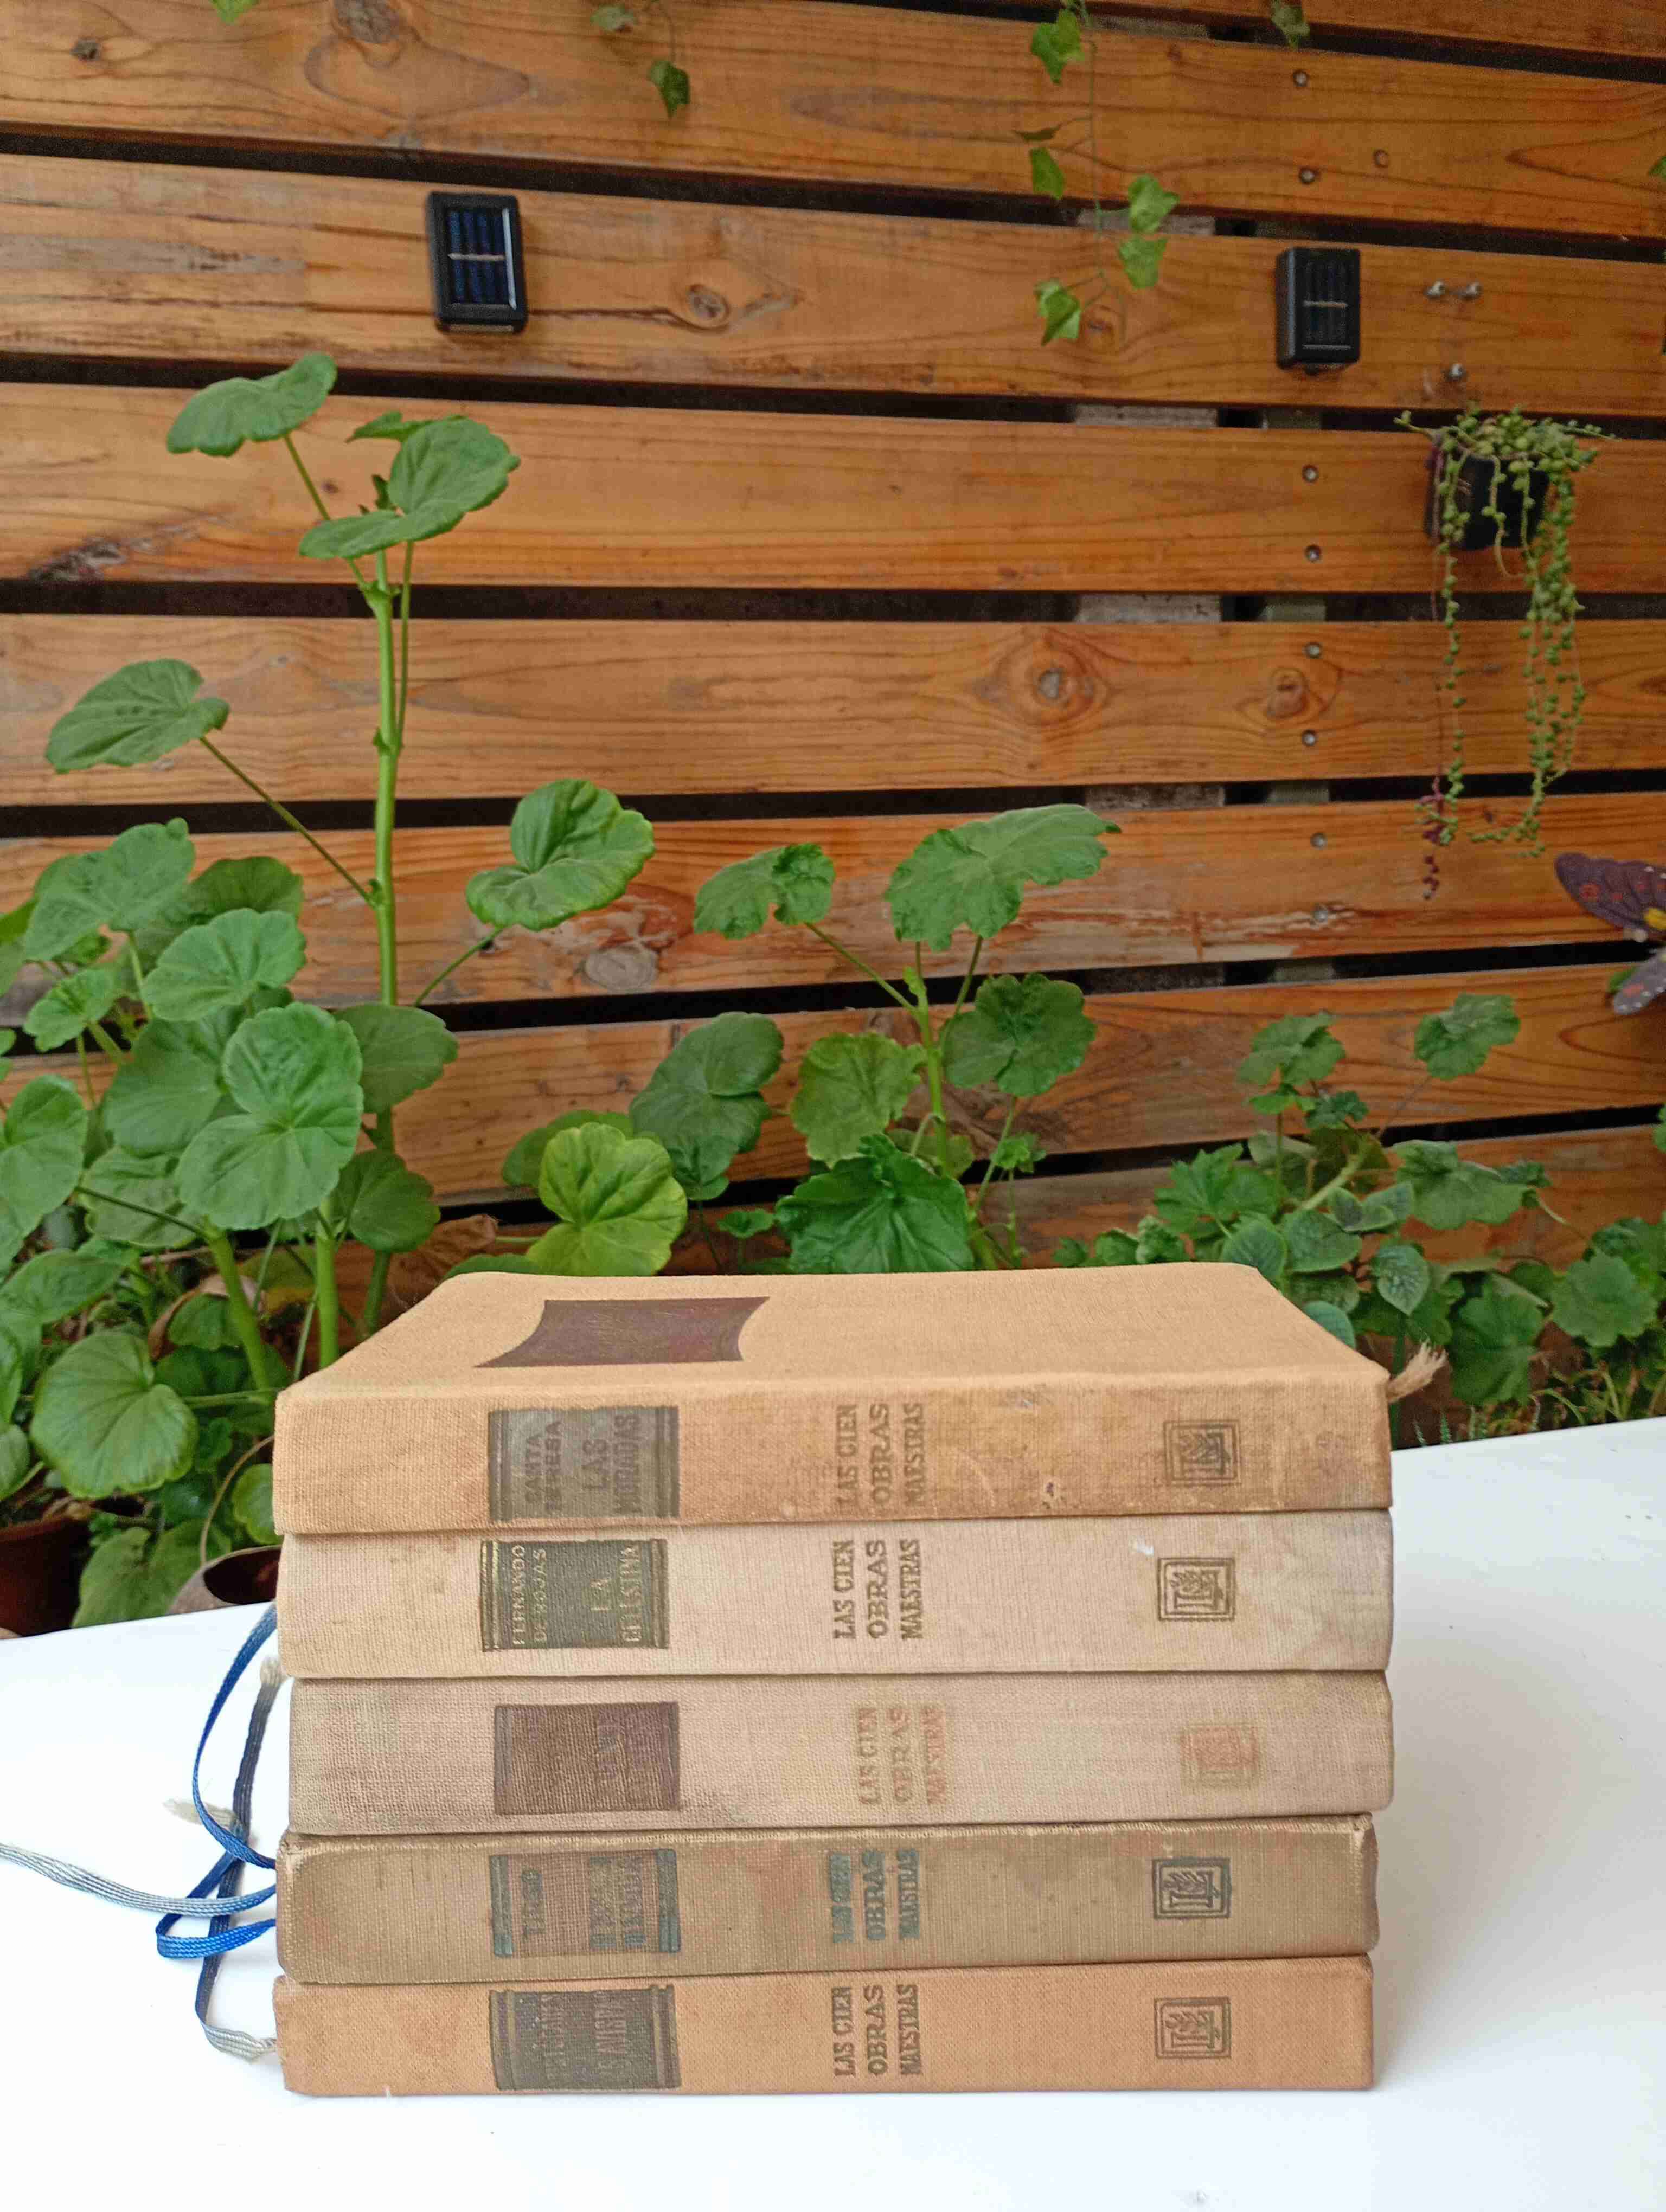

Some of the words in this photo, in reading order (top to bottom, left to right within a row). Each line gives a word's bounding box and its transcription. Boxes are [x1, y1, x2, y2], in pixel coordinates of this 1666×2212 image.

[524, 1434, 542, 1504] SANTA
[544, 1420, 562, 1512] TERESA
[581, 1438, 608, 1491] LAS
[613, 1413, 642, 1514] MORADAS
[836, 1405, 858, 1458] CIEN
[869, 1403, 892, 1505] OBRAS
[903, 1403, 925, 1507] MAESTRAS
[836, 1466, 858, 1506] LAS
[512, 1545, 526, 1644] FERNANDO
[533, 1548, 547, 1614] ROJAS
[590, 1578, 613, 1612] LA
[620, 1545, 643, 1642] CELESTINA
[833, 1540, 854, 1593] CIEN
[866, 1539, 888, 1638] OBRAS
[899, 1539, 922, 1641] MAESTRAS
[833, 1600, 855, 1639] LAS
[888, 1707, 912, 1803] OBRAS
[863, 1849, 886, 1940] OBRAS
[898, 1849, 920, 1941] MAESTRAS
[832, 1986, 854, 2036] CIEN
[863, 1985, 888, 2076] OBRAS
[897, 1984, 922, 2075] MAESTRAS
[833, 2042, 855, 2078] LAS
